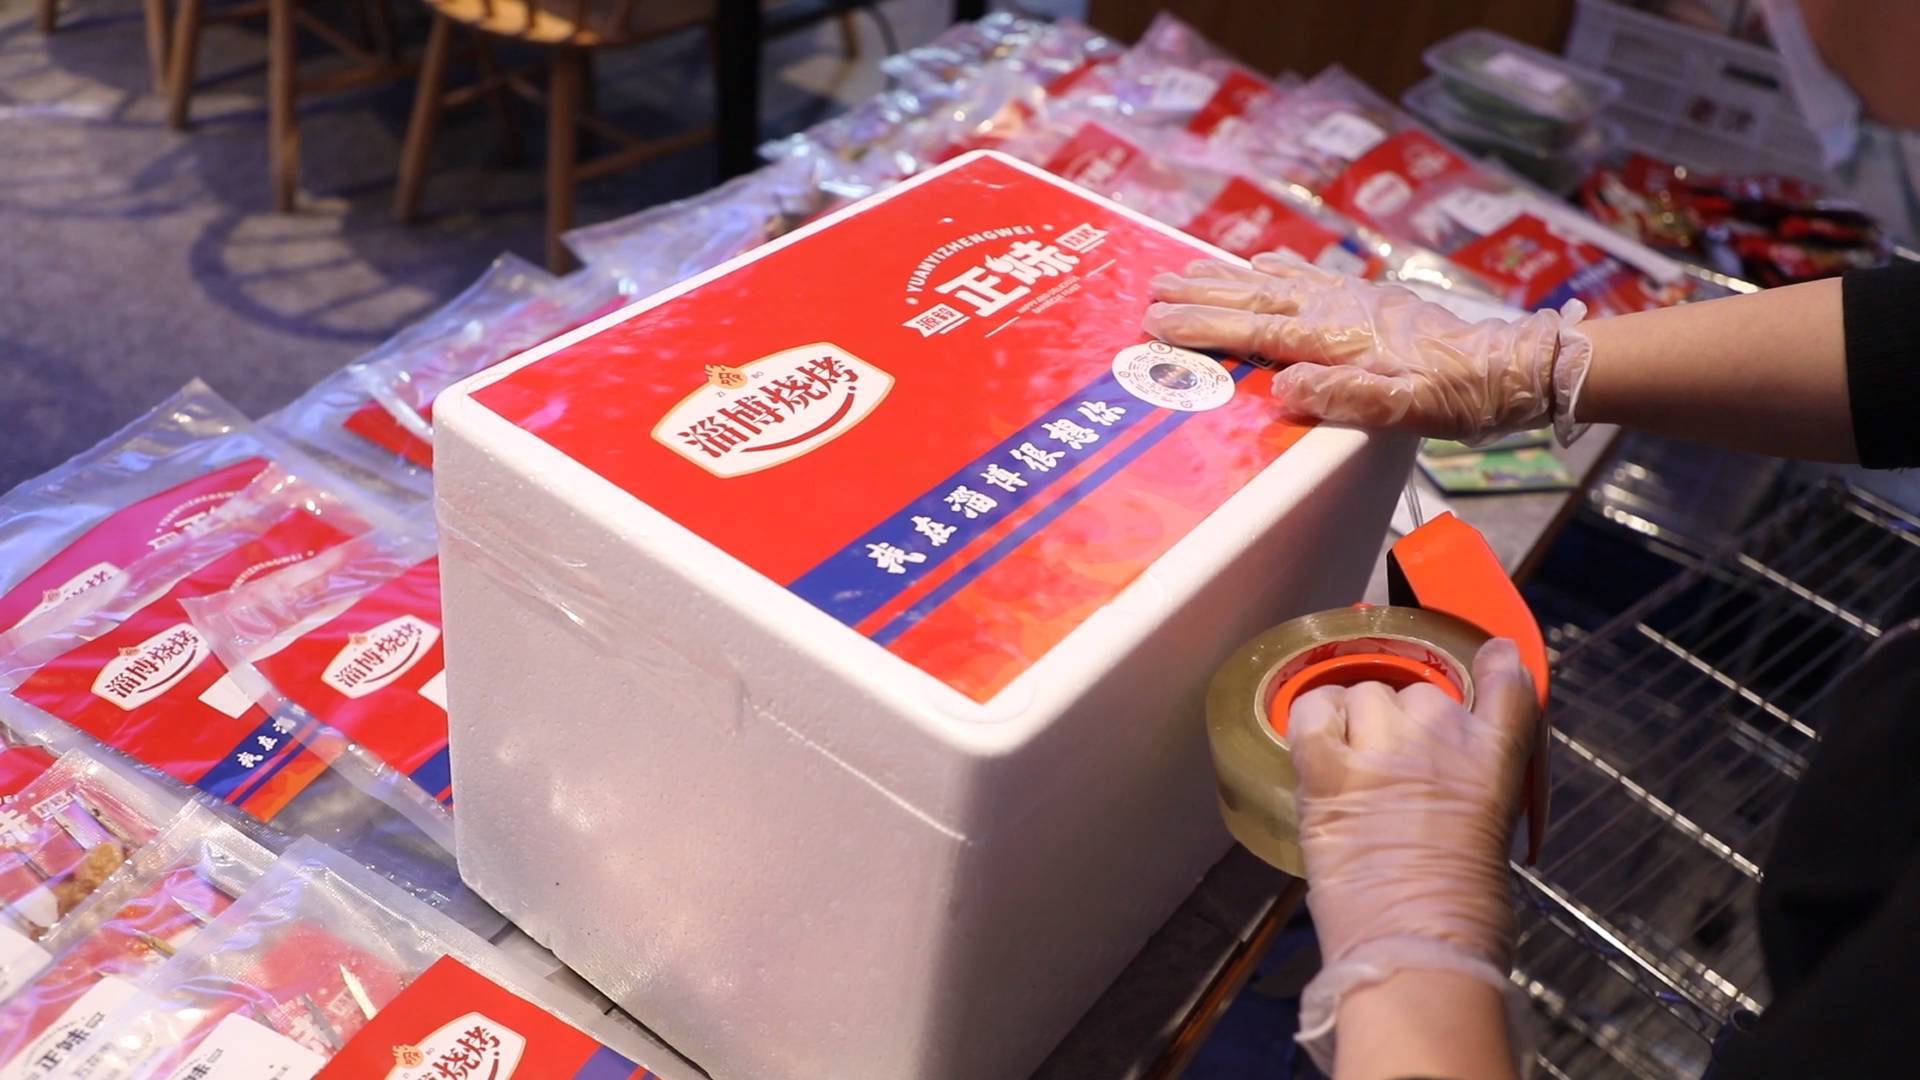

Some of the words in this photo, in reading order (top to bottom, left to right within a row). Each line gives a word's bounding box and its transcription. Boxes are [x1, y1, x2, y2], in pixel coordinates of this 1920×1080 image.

[906, 225, 1035, 293] YUANYIZHENGWEI
[934, 239, 1081, 317] 正味
[676, 356, 860, 458] 淄博烧烤
[864, 399, 1127, 574] 我在淄博很想你
[104, 630, 199, 698] 淄博烧烤
[334, 622, 423, 688] 淄博烧烤
[417, 1026, 501, 1080] 烧烤
